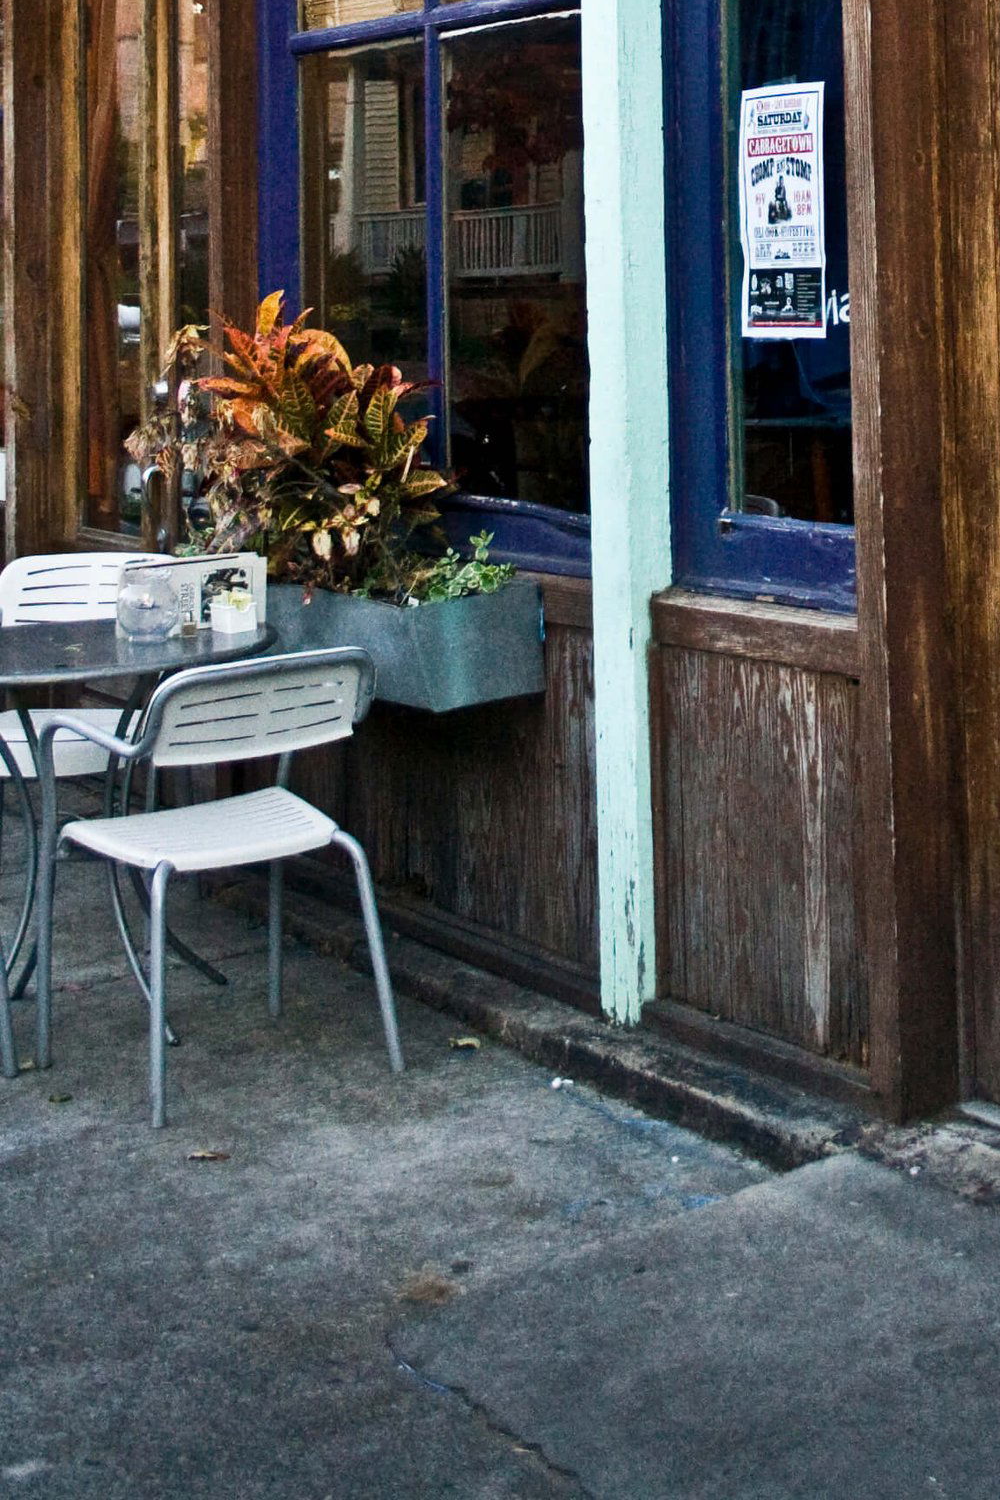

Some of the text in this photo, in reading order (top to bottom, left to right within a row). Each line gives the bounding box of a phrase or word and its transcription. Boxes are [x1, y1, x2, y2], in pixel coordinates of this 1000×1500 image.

[757, 111, 803, 127] SATURDAY
[749, 134, 813, 156] CABBAGETOWN
[751, 157, 774, 187] CHOMP
[786, 156, 812, 182] STOMP
